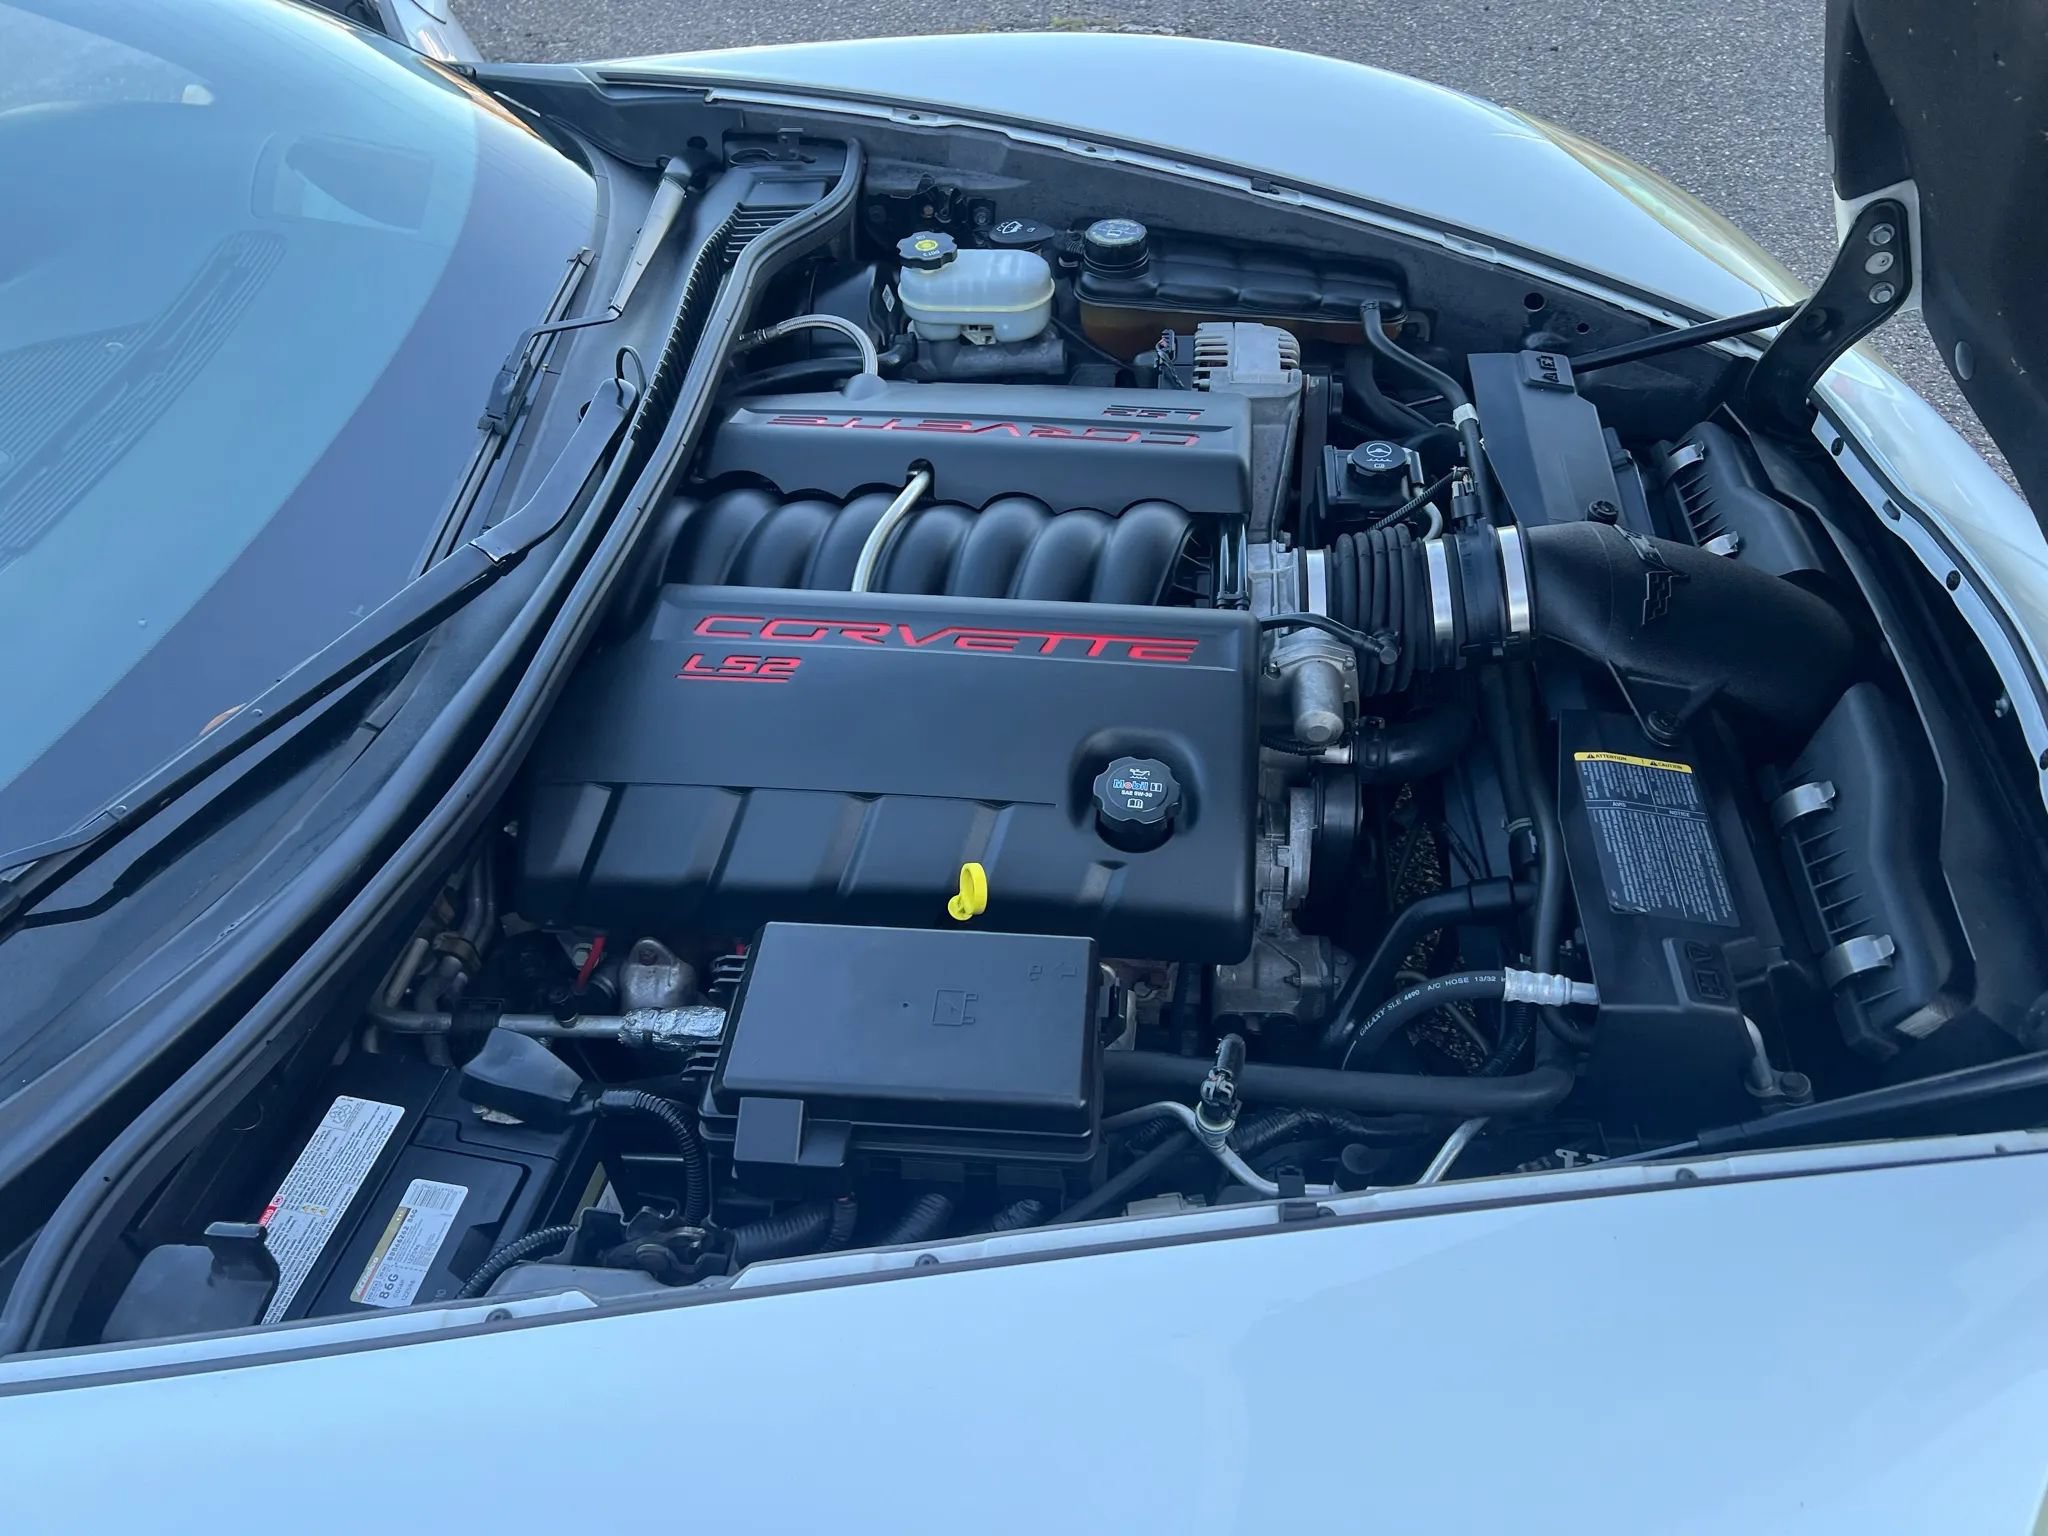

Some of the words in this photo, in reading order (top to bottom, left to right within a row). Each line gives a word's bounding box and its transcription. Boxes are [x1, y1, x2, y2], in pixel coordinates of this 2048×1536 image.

[1102, 405, 1206, 419] LS2
[767, 416, 1200, 447] CORVETTE
[692, 615, 1199, 662] CORVETTE
[677, 653, 803, 681] LS2
[1657, 761, 1683, 770] CAUTION
[1113, 779, 1149, 791] Mobil
[1359, 1007, 1386, 1037] GALAXY
[1427, 982, 1441, 991] A/C
[1445, 976, 1469, 987] HOSE
[379, 1273, 399, 1300] 86G
